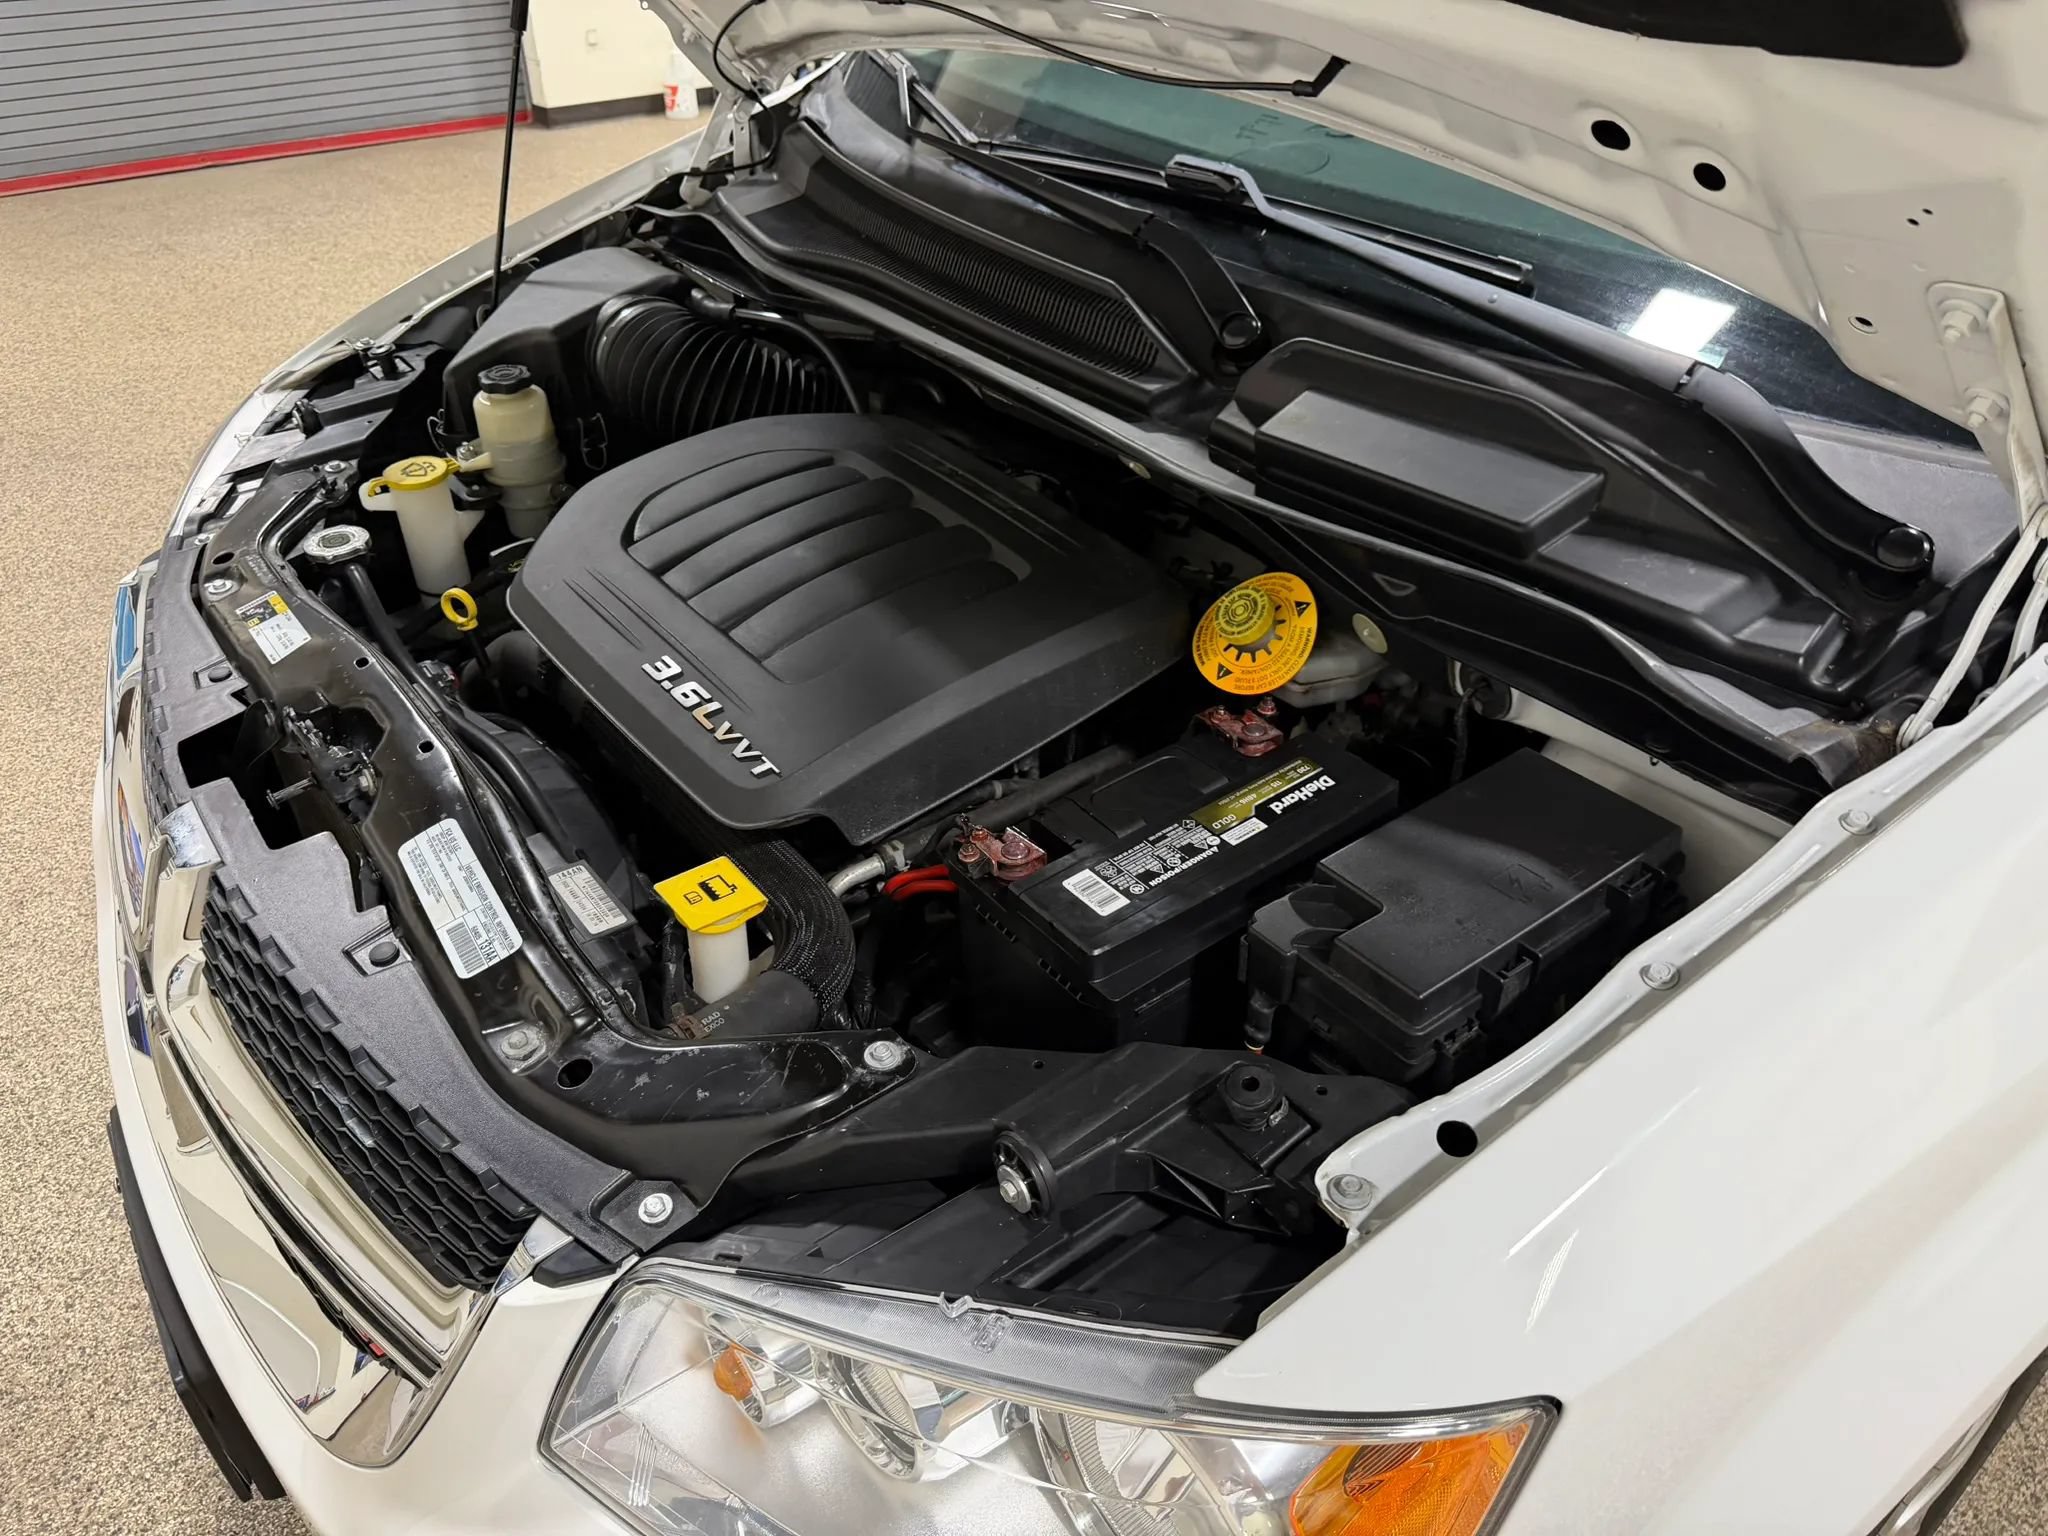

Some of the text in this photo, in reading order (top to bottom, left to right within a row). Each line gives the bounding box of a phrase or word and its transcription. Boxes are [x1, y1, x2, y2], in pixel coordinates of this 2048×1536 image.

[641, 655, 780, 776] 3.6L VVT
[1268, 774, 1335, 815] DieHard
[1211, 813, 1236, 829] GOLD
[1148, 848, 1213, 886] DANGER/POISON
[463, 864, 478, 882] VEHICLE
[473, 880, 489, 902] EMISSION
[483, 900, 499, 921] CONTROL
[494, 919, 516, 950] INFORMATION
[478, 938, 497, 963] 131AA
[701, 1011, 721, 1025] RAD
[703, 1017, 725, 1032] EXICO
